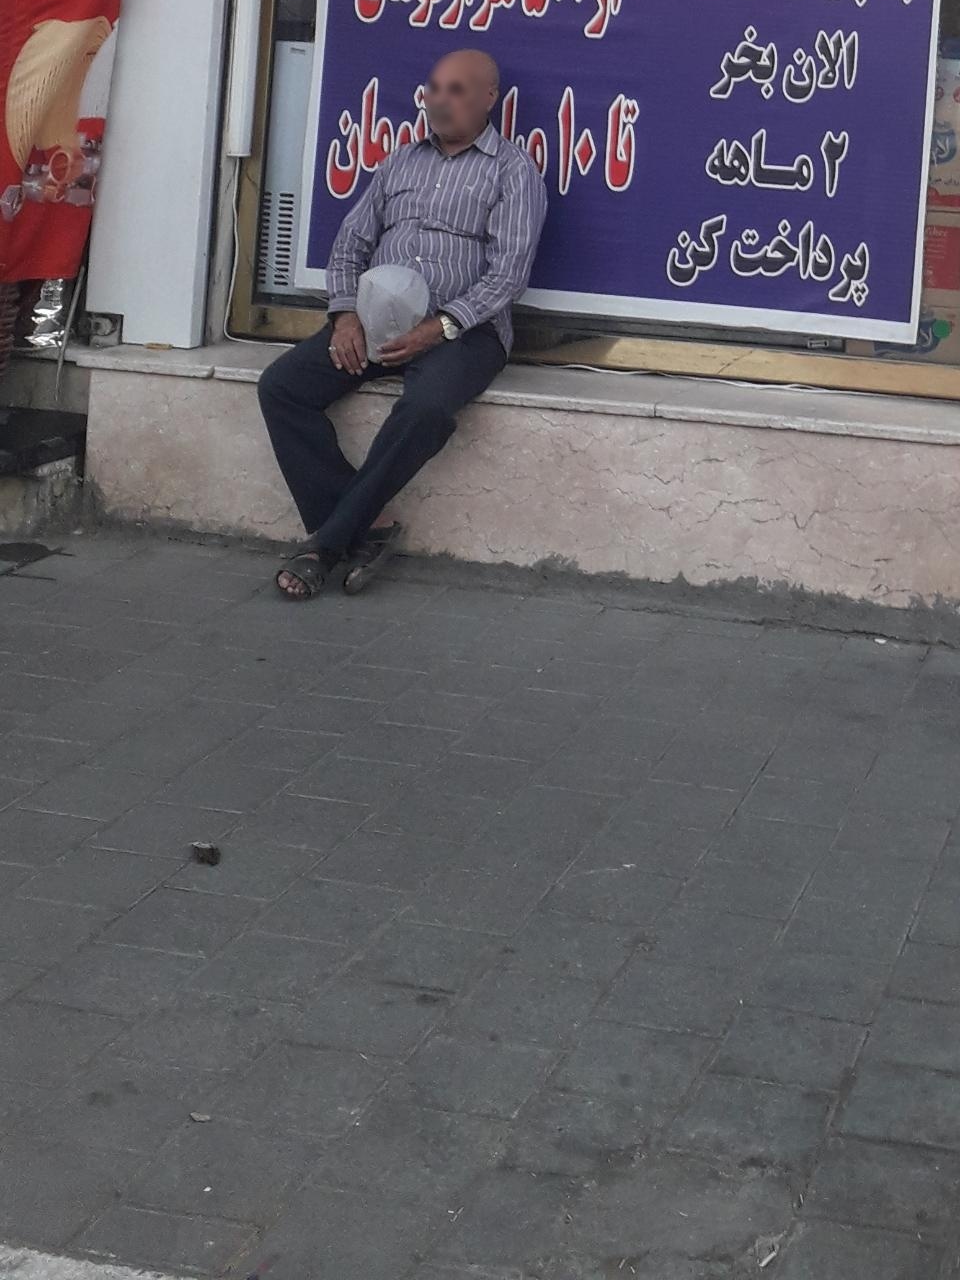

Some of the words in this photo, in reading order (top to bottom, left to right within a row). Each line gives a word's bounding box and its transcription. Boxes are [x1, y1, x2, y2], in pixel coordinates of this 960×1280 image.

[710, 26, 776, 98] بخر
[783, 30, 858, 103] الان
[558, 87, 596, 196] ۱۰
[605, 94, 640, 192] تا
[706, 130, 813, 190] ماهه
[821, 131, 849, 197] ۲
[667, 216, 726, 286] کن
[731, 220, 869, 307] پرداخت
